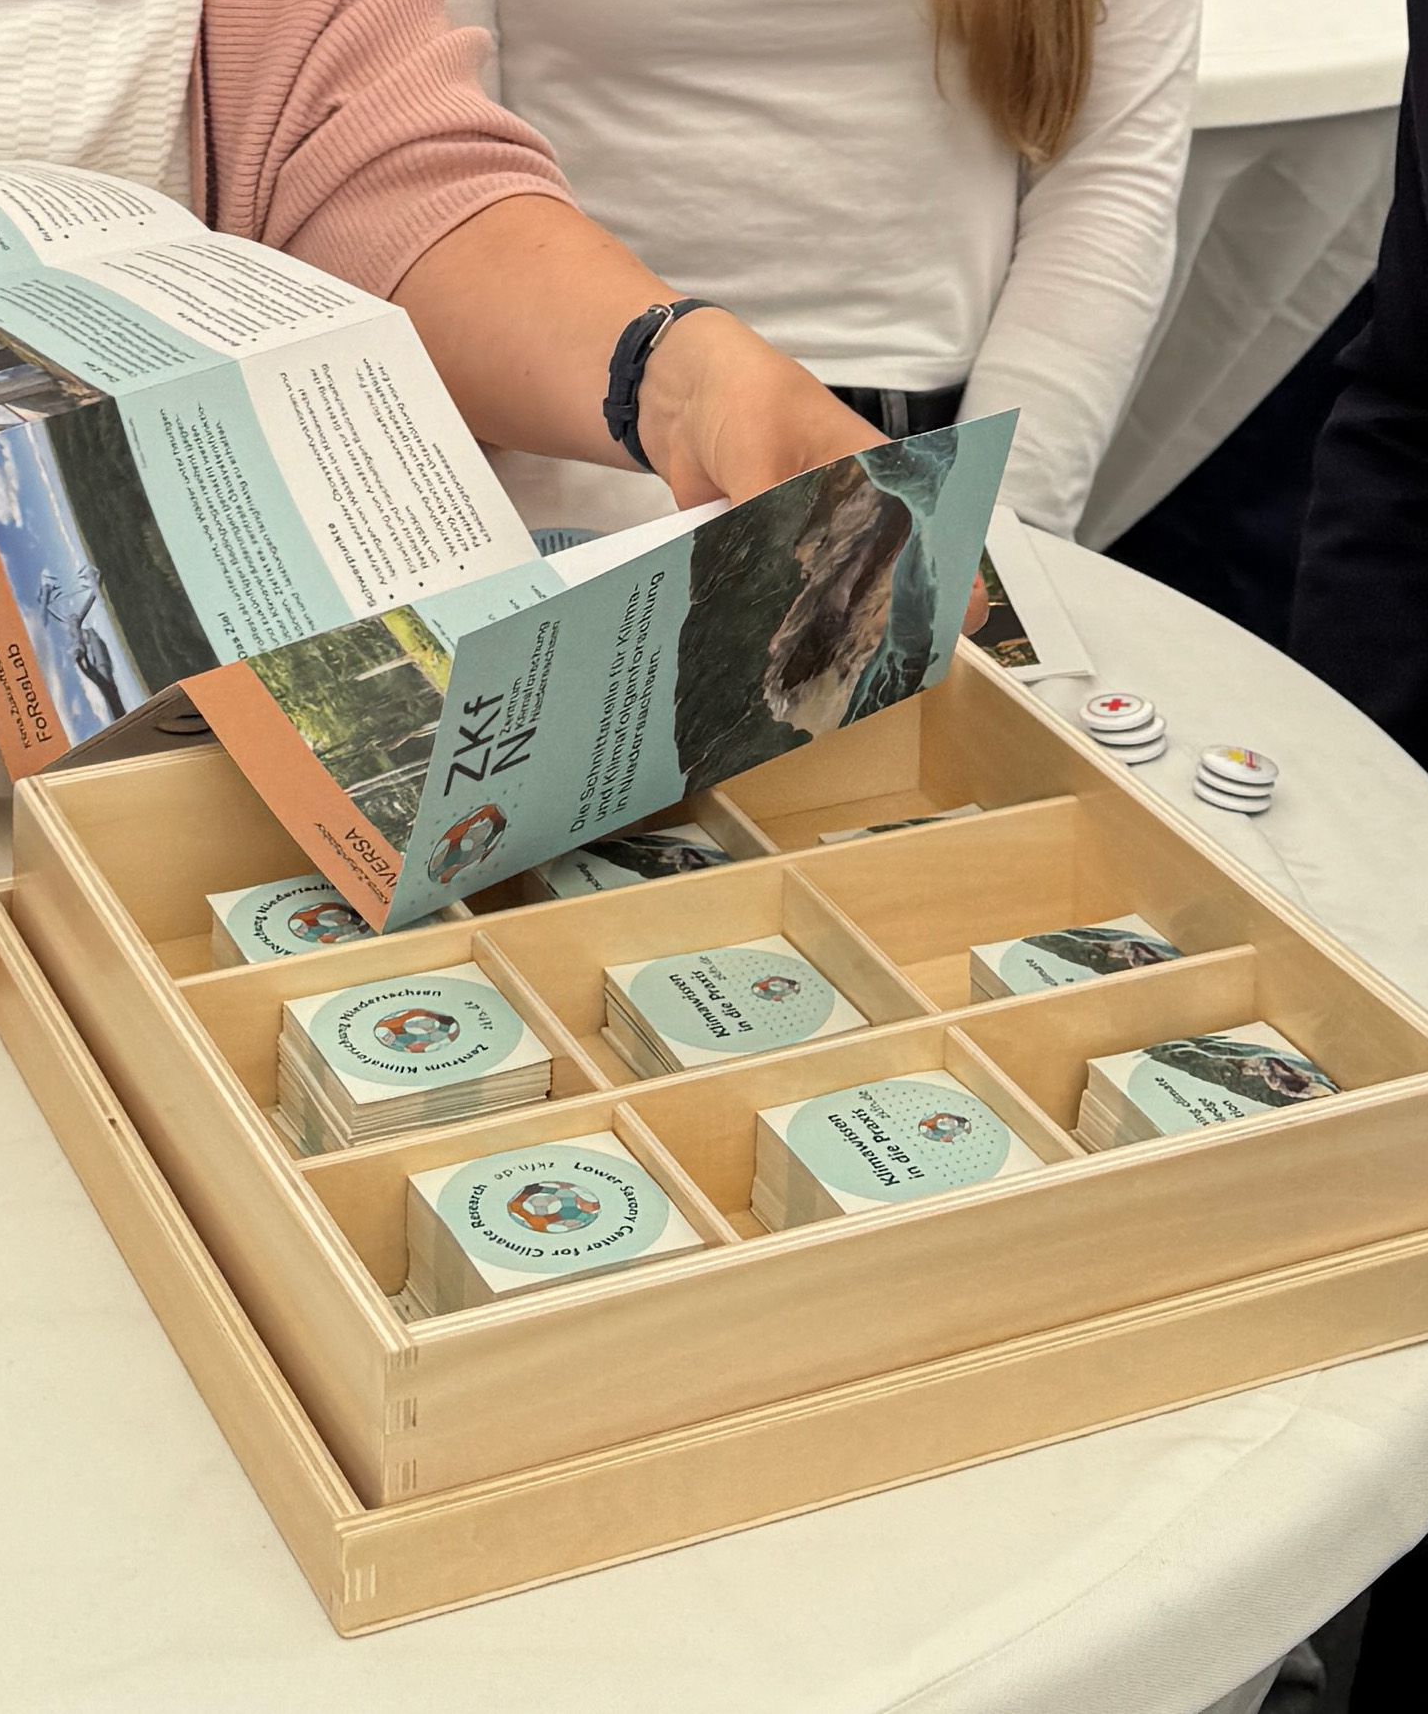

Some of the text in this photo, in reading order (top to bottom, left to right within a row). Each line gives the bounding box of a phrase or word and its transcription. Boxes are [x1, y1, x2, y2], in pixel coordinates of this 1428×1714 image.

[326, 520, 377, 609] Schwerpunkte
[216, 610, 249, 661] Das Ziel
[615, 583, 644, 643] Klima-
[3, 642, 52, 743] FoResLab
[517, 622, 550, 729] Klimaforschung
[594, 571, 665, 821] und Klimafolgenforschung
[607, 649, 627, 678] für
[444, 694, 504, 796] ZKf
[491, 678, 537, 775] N Zentrum
[577, 680, 621, 802] Schnittstelle
[570, 801, 592, 833] Die
[612, 796, 629, 813] in
[345, 828, 397, 890] IVERSA
[669, 974, 730, 1037] Klimawissen
[692, 971, 753, 1032] in die Praxis
[425, 1043, 488, 1071] Zentrum
[494, 1162, 554, 1180] zkfn.de
[828, 1114, 900, 1186] Klimawissen
[852, 1109, 925, 1179] in die Praxis
[470, 1162, 638, 1257] Lower Saxony Center for Climate Research
